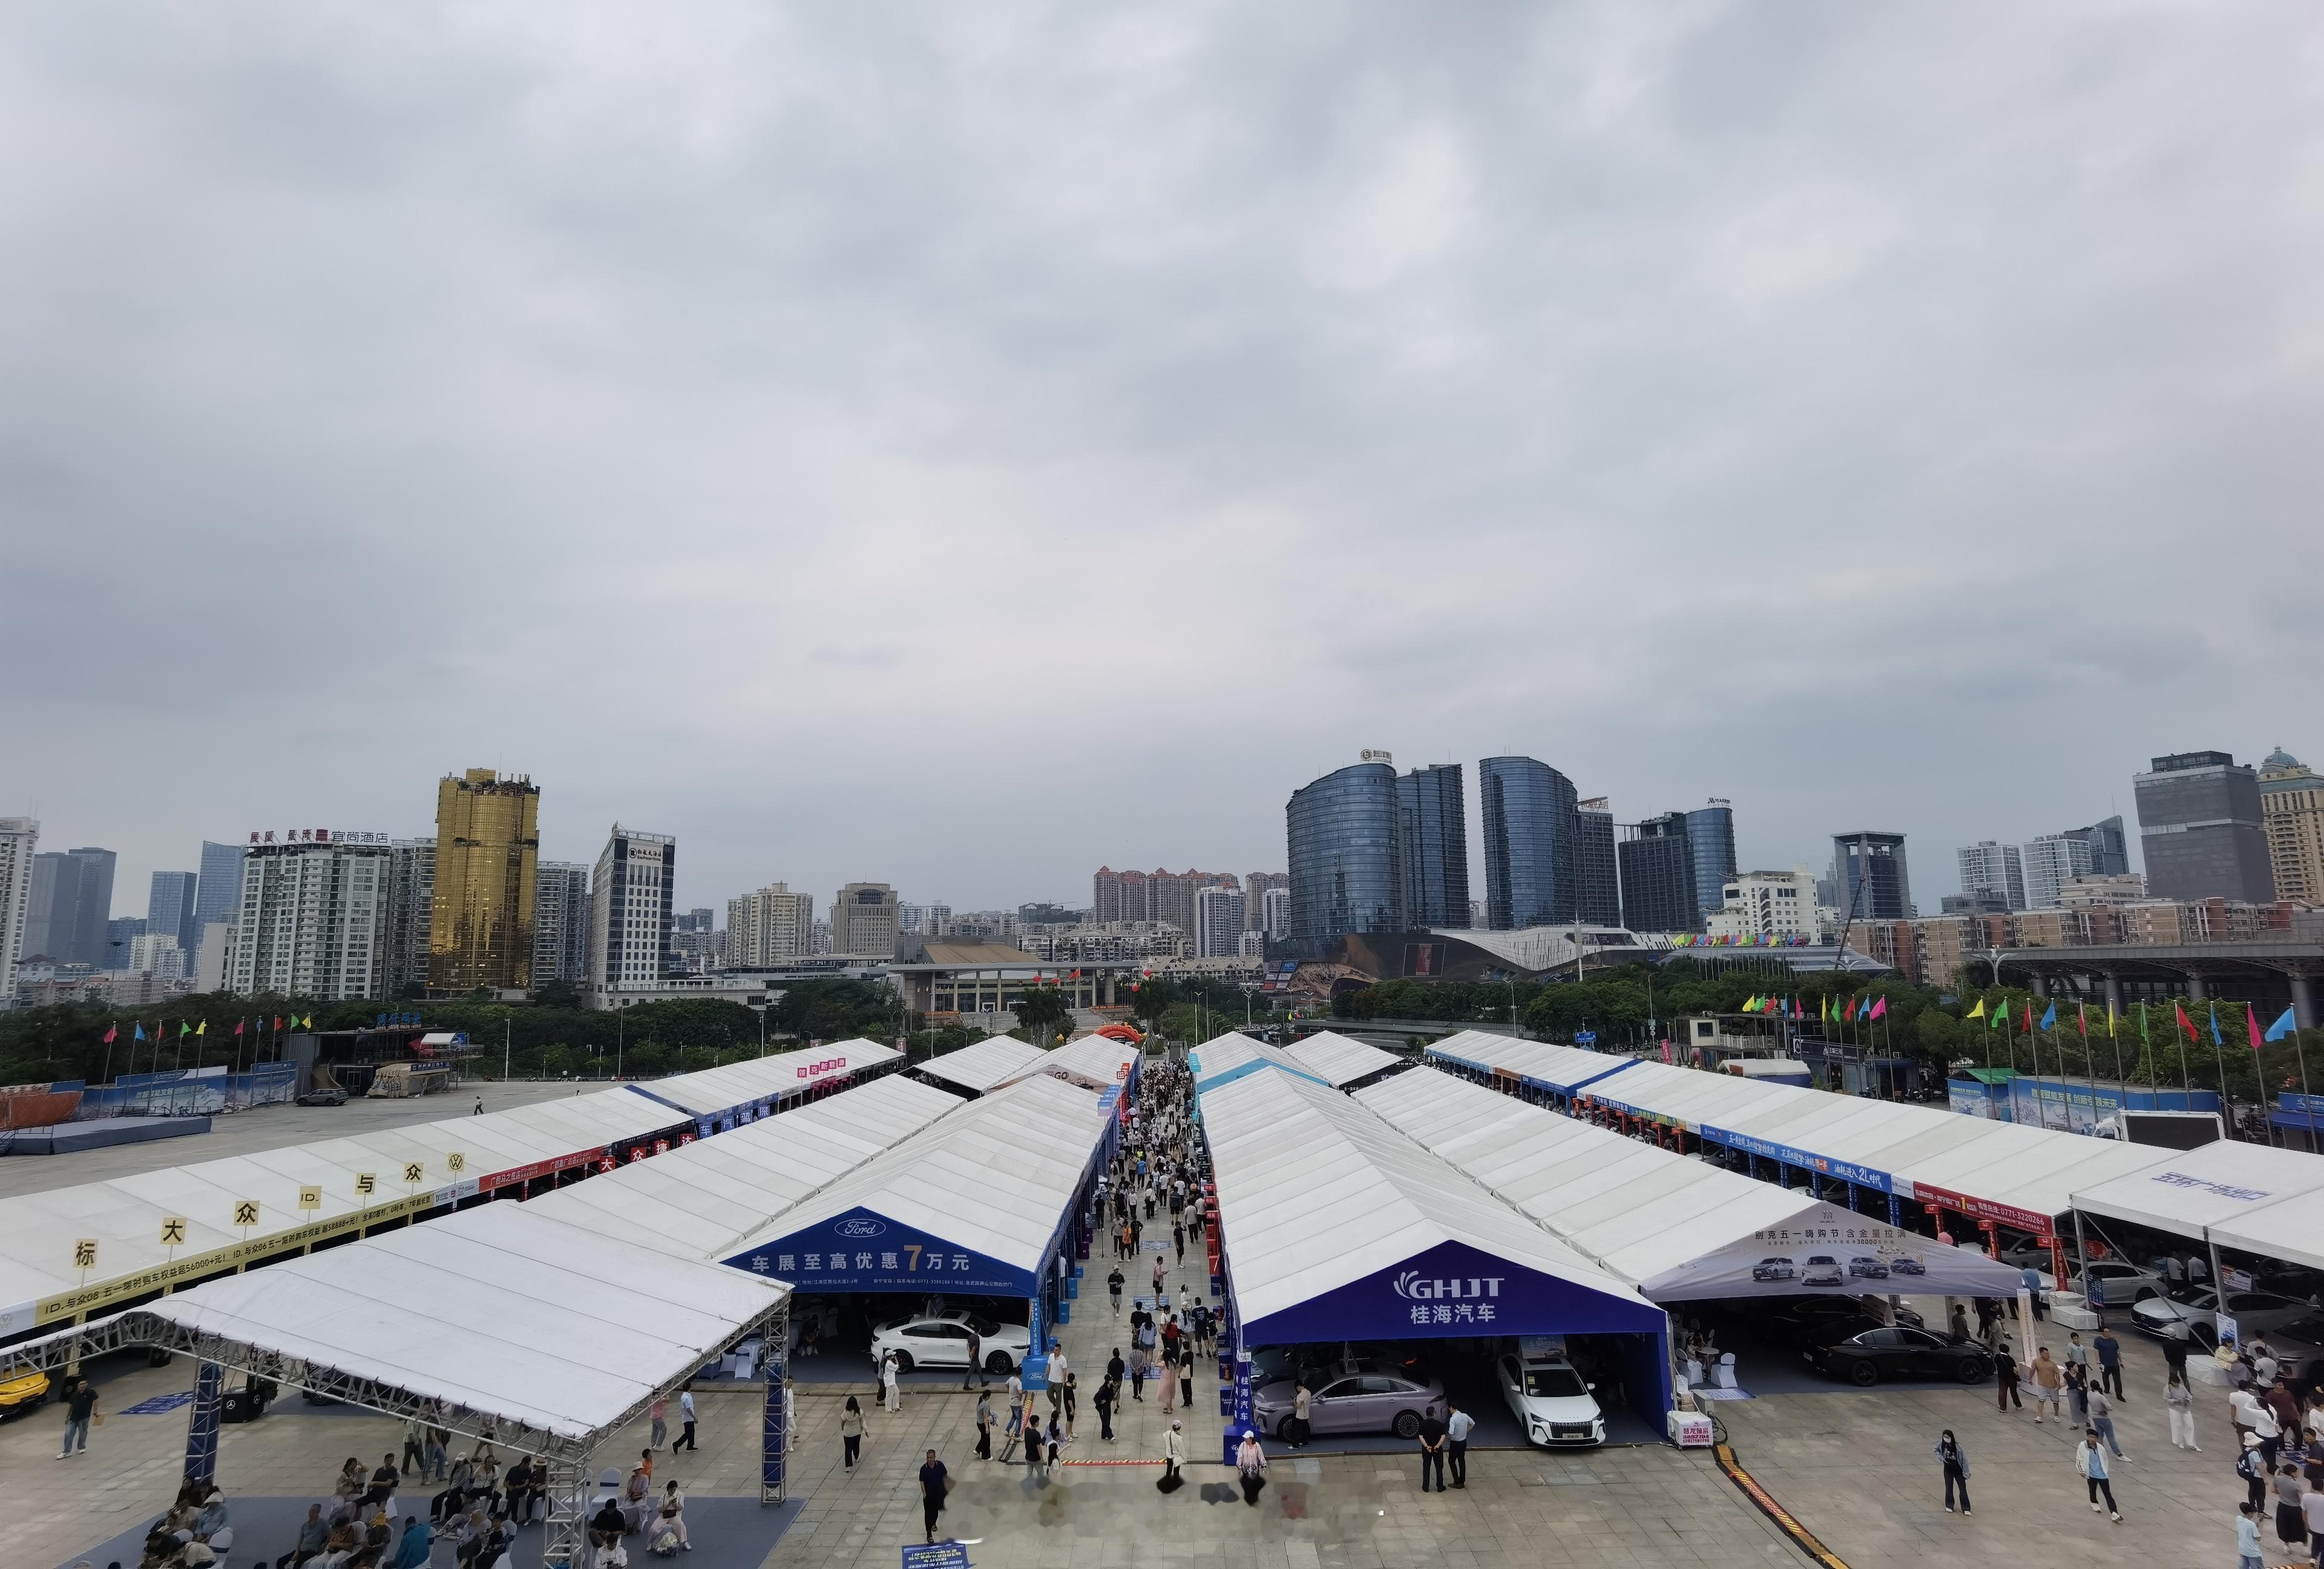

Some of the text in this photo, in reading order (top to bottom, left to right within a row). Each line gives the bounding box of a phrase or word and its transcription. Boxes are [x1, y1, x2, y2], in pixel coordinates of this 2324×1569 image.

[332, 831, 388, 843] 宜尚酒店
[701, 1125, 711, 1136] 车
[723, 1118, 733, 1129] 汽
[741, 1112, 751, 1122] 蓝
[759, 1106, 769, 1116] 深
[601, 1158, 612, 1171] 大
[632, 1150, 644, 1162] 众
[2151, 1171, 2272, 1201] 五环广场出口
[76, 1242, 96, 1268] 标
[164, 1220, 183, 1243] 大
[237, 1203, 257, 1223] 众
[356, 1175, 375, 1192] 与
[405, 1164, 421, 1182] 众
[844, 1220, 877, 1235] Ford
[752, 1245, 970, 1272] 车展至高优惠7万元
[1409, 1278, 1505, 1299] GHJT
[1411, 1303, 1495, 1324] 桂海汽车
[1240, 1376, 1249, 1421] 桂海汽车
